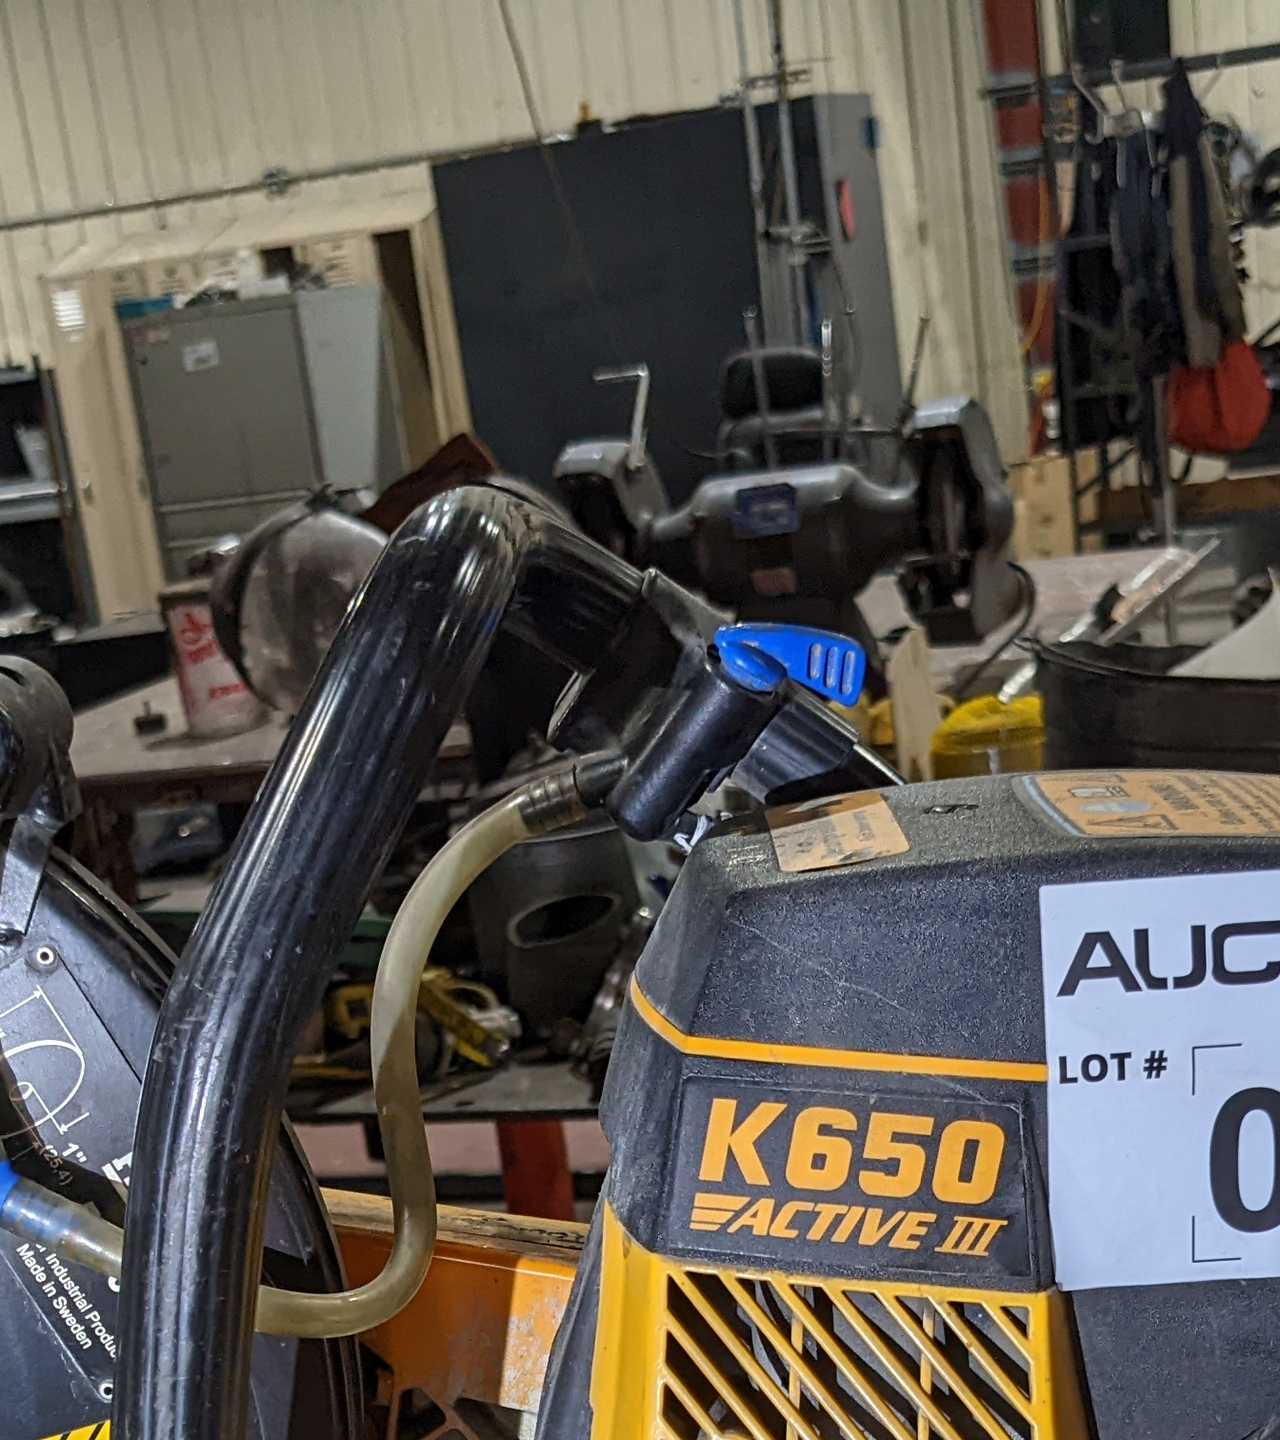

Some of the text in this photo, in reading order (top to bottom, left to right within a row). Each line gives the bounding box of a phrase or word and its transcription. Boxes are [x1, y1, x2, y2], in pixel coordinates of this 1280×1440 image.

[1058, 1050, 1168, 1084] LOT #
[698, 1098, 1005, 1205] K650
[726, 1198, 1008, 1257] ACTIVE III
[15, 1242, 92, 1350] Made in Sweden
[45, 1252, 93, 1313] Industrial
